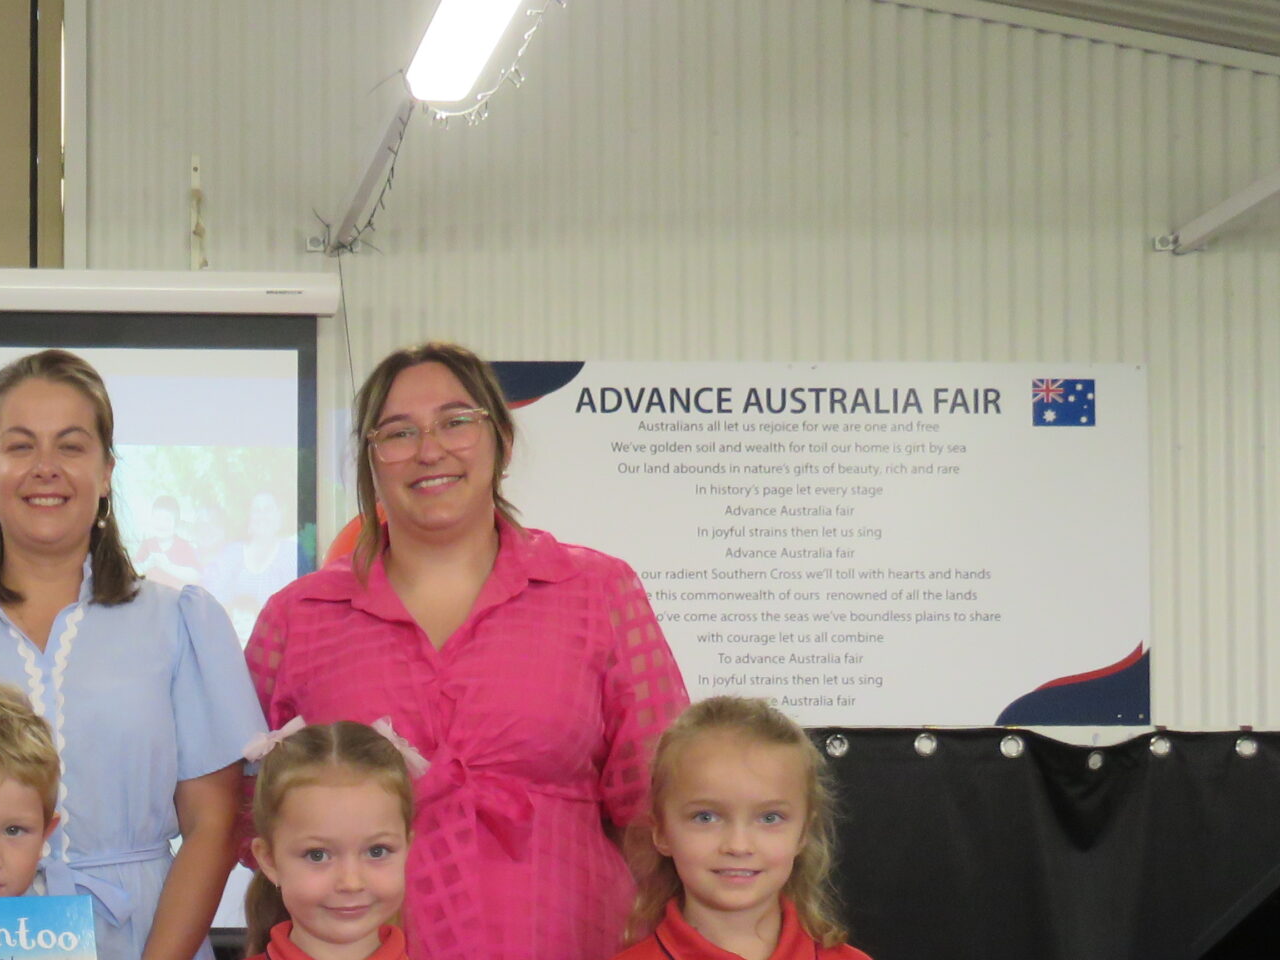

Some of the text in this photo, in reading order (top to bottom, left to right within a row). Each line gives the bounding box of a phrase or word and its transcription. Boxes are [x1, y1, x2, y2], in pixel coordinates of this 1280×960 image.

[575, 386, 1002, 415] ADVANCE AUSTRALIA FAIR
[638, 420, 940, 434] Australians all let us rejoice for we are one and free
[610, 441, 647, 453] We've
[649, 441, 692, 455] golden
[695, 441, 716, 453] soil
[718, 441, 742, 453] and
[744, 442, 786, 453] wealth
[788, 441, 806, 453] for
[617, 462, 960, 477] Our land abounds in nature's gifts of beauty, rich and rare
[641, 570, 662, 580] our
[655, 589, 978, 600] this commonwealth of ours renowned of all the lands
[683, 613, 718, 622] come
[720, 613, 758, 622] across
[760, 611, 781, 622] the
[784, 613, 810, 622] seas
[812, 611, 847, 622] we've
[849, 610, 912, 622] boundless
[915, 611, 951, 624] plains
[953, 612, 967, 621] to
[969, 610, 1002, 622] share
